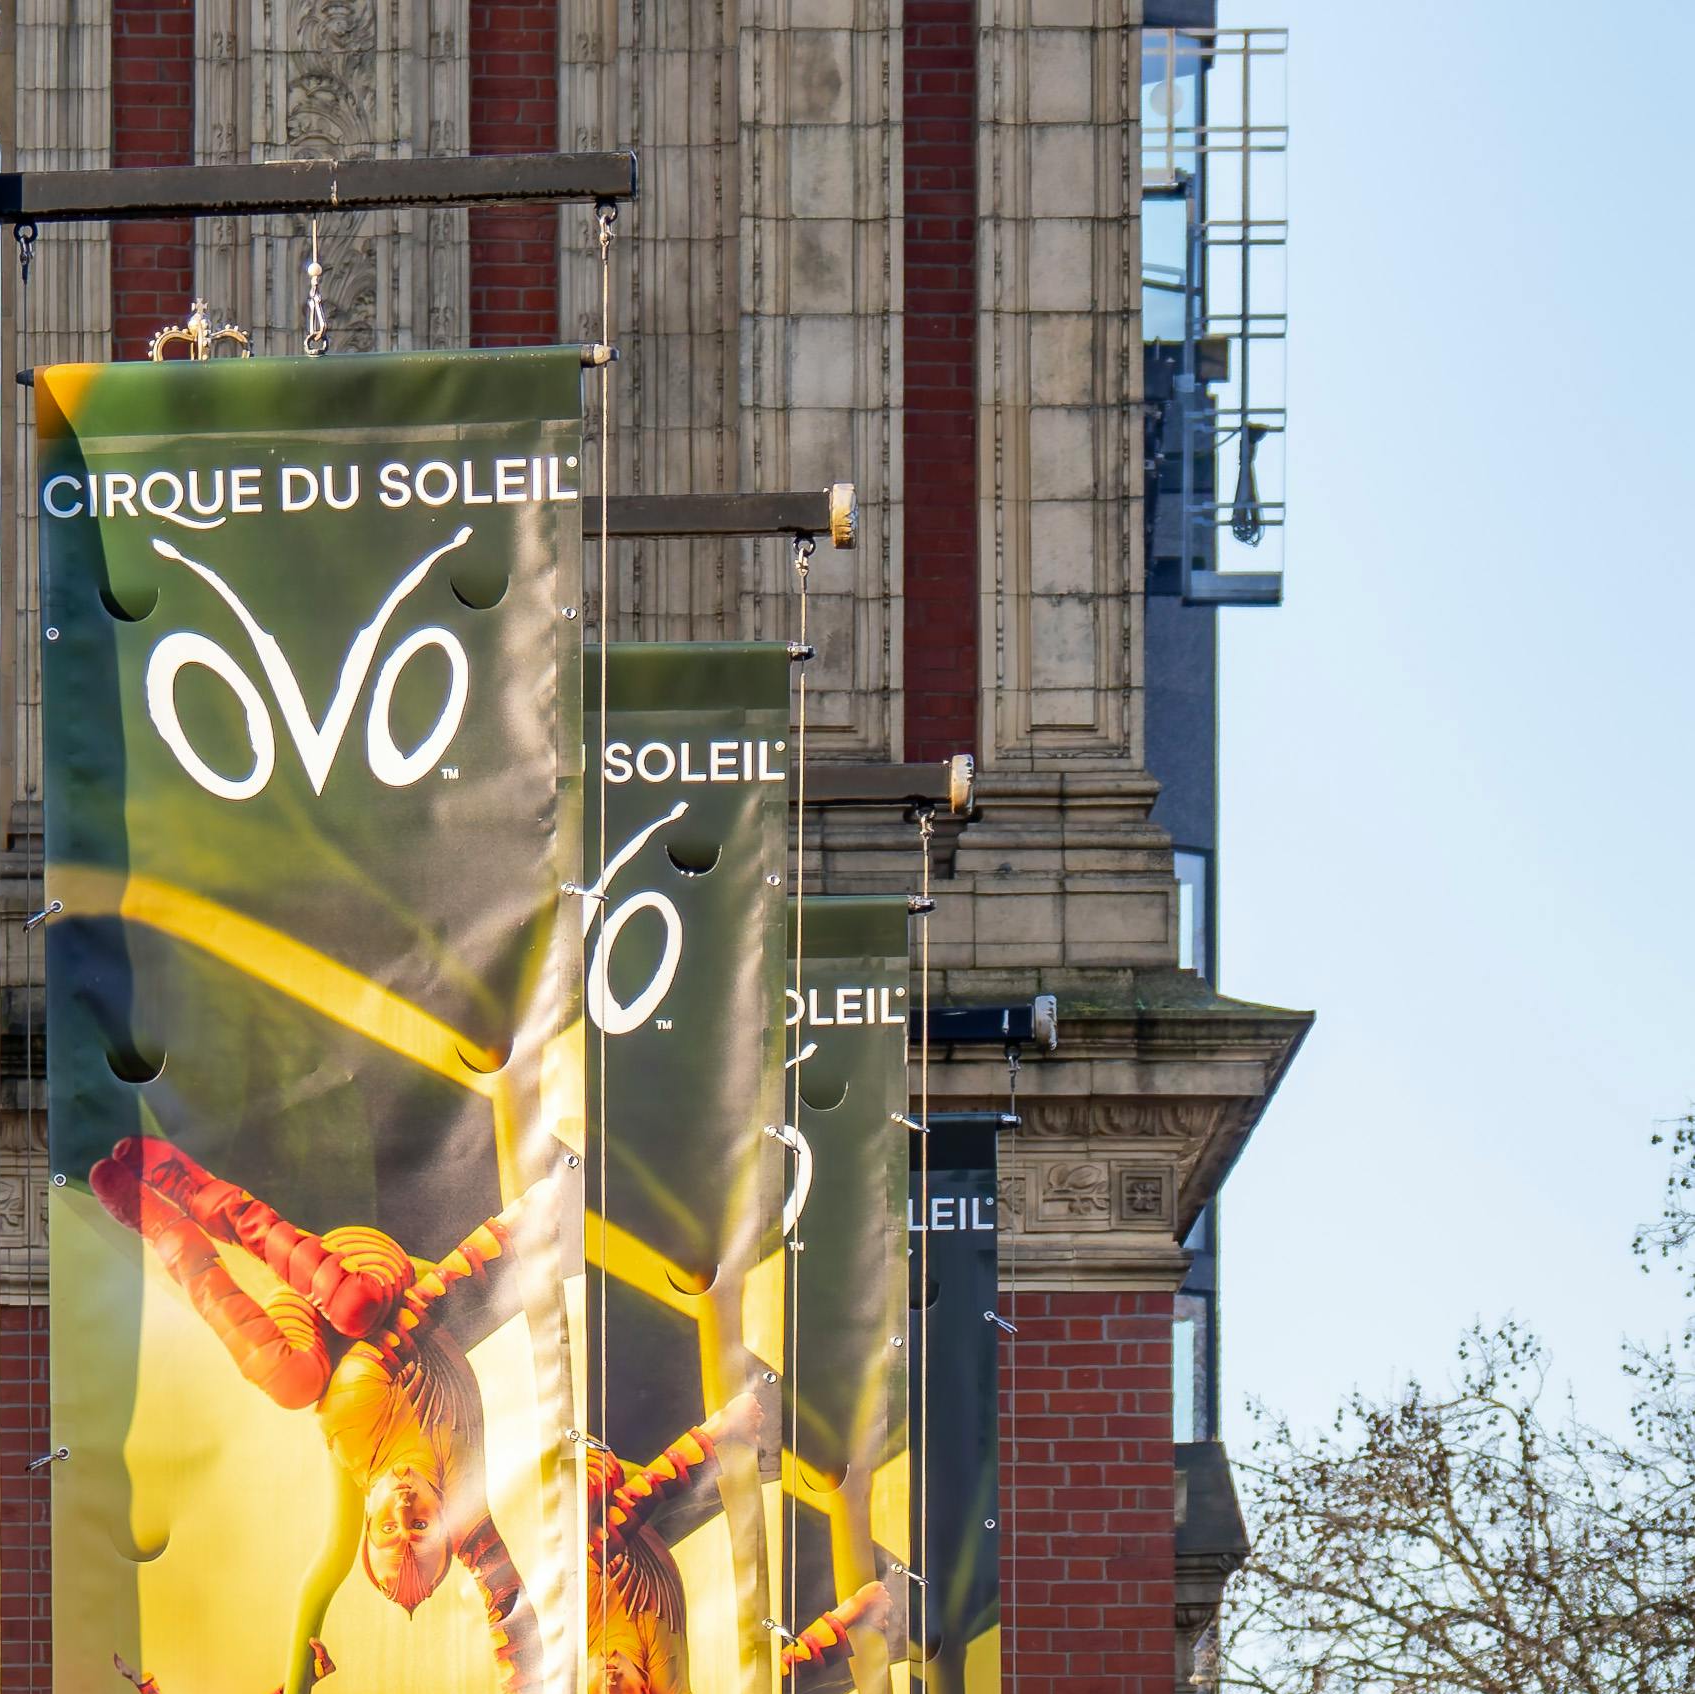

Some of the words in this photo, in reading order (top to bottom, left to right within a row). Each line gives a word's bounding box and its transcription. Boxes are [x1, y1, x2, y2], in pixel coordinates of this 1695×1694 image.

[43, 467, 263, 530] CIRQUE
[281, 465, 359, 512] DU
[146, 525, 474, 801] OVO
